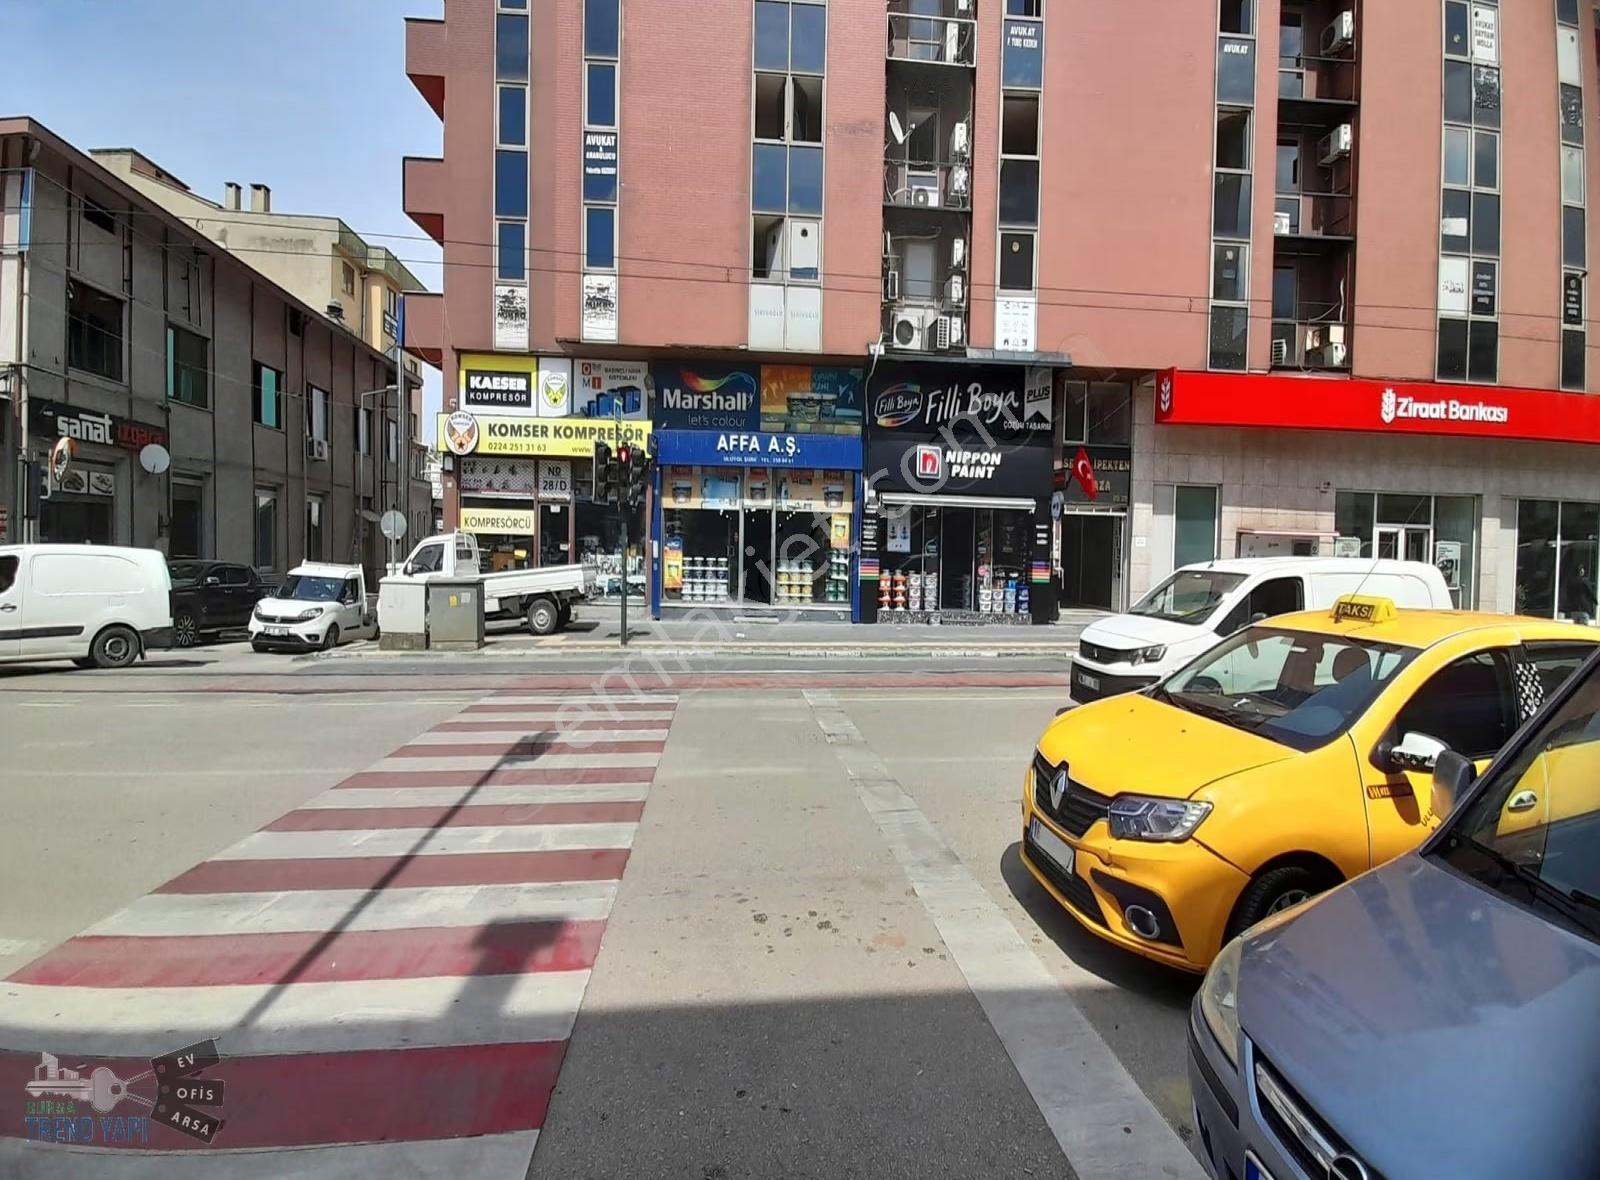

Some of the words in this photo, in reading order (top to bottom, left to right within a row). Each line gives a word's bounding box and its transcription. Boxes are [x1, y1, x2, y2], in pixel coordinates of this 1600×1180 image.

[1010, 26, 1036, 36] AVUKAT
[1224, 44, 1248, 54] AVUKAT
[586, 135, 616, 146] AVUKAT
[470, 376, 527, 391] KAESER
[470, 391, 527, 402] KOMPRESÖR
[663, 388, 747, 411] Marshall
[1027, 385, 1051, 400] PLUS
[880, 396, 895, 412] Filli
[897, 395, 919, 412] Boya
[925, 384, 962, 425] Filli
[967, 383, 1019, 424] Boya
[1396, 396, 1447, 419] Ziraat
[1448, 399, 1508, 422] Bankası
[688, 413, 709, 426] let's
[711, 414, 747, 428] colour
[56, 413, 114, 444] sanat
[488, 423, 549, 439] KOMSER
[553, 423, 643, 441] KOMPRESÖR
[488, 442, 508, 452] 0224
[509, 443, 524, 452] 251
[525, 443, 535, 452] 31
[717, 434, 760, 452] AFFA
[767, 435, 801, 457] A.Ş.
[946, 450, 1002, 466] NIPPON
[952, 466, 995, 479] PAINT
[542, 480, 567, 492] 28/D
[464, 516, 531, 529] KOMPRESÖRCÜ
